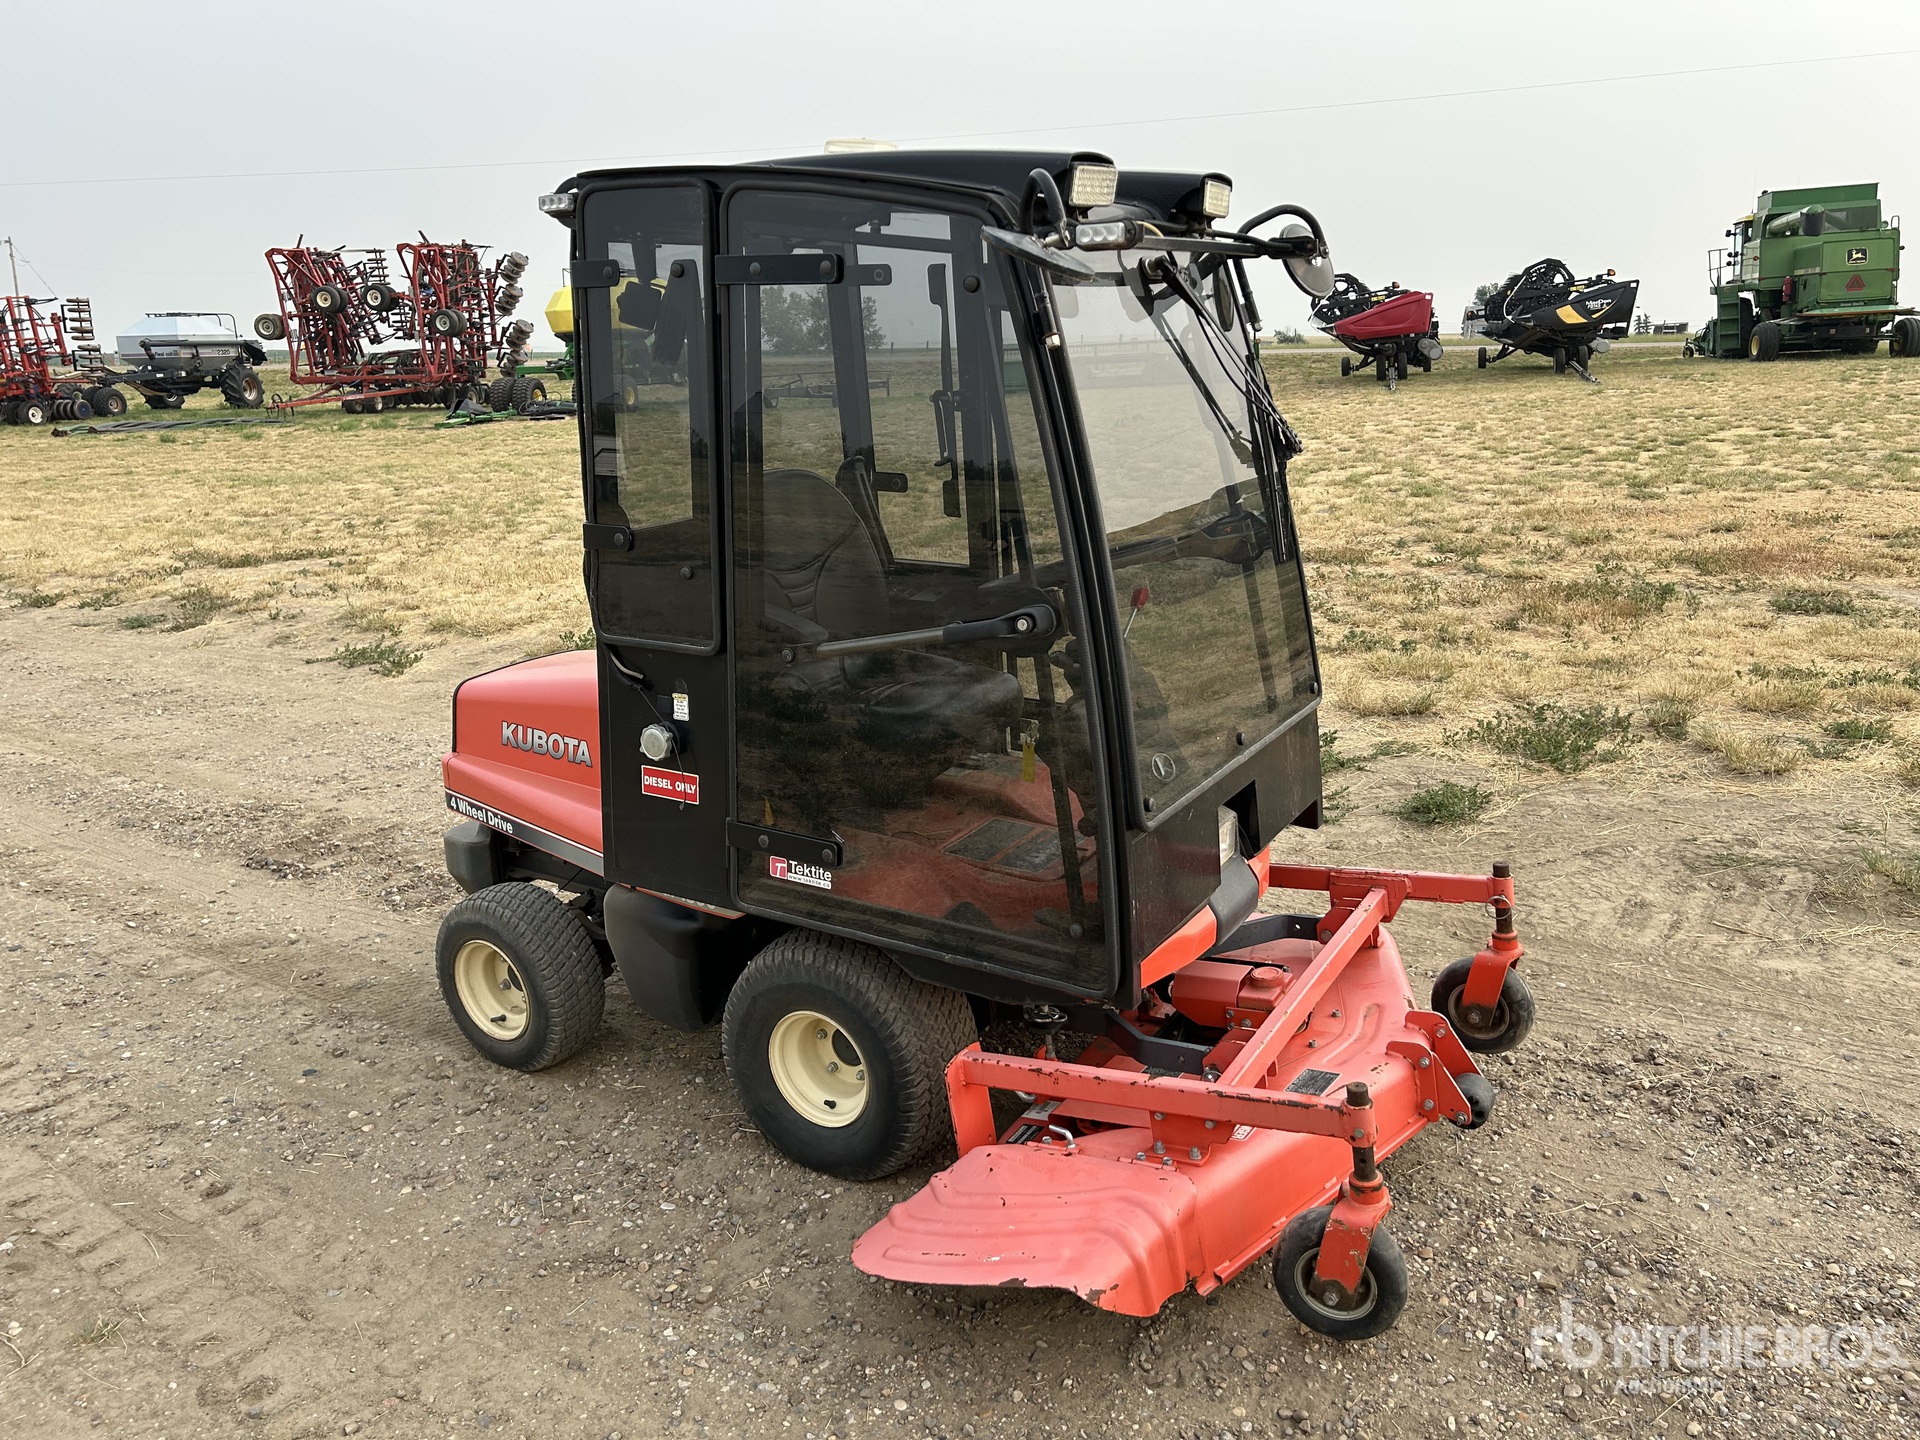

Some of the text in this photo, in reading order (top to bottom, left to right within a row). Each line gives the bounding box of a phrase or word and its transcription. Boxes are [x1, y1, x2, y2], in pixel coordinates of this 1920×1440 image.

[502, 721, 592, 767] KUBOTA
[644, 775, 697, 794] DIESEL ONLY
[450, 796, 513, 834] 4 Wheel Drive
[789, 860, 832, 881] Tektite
